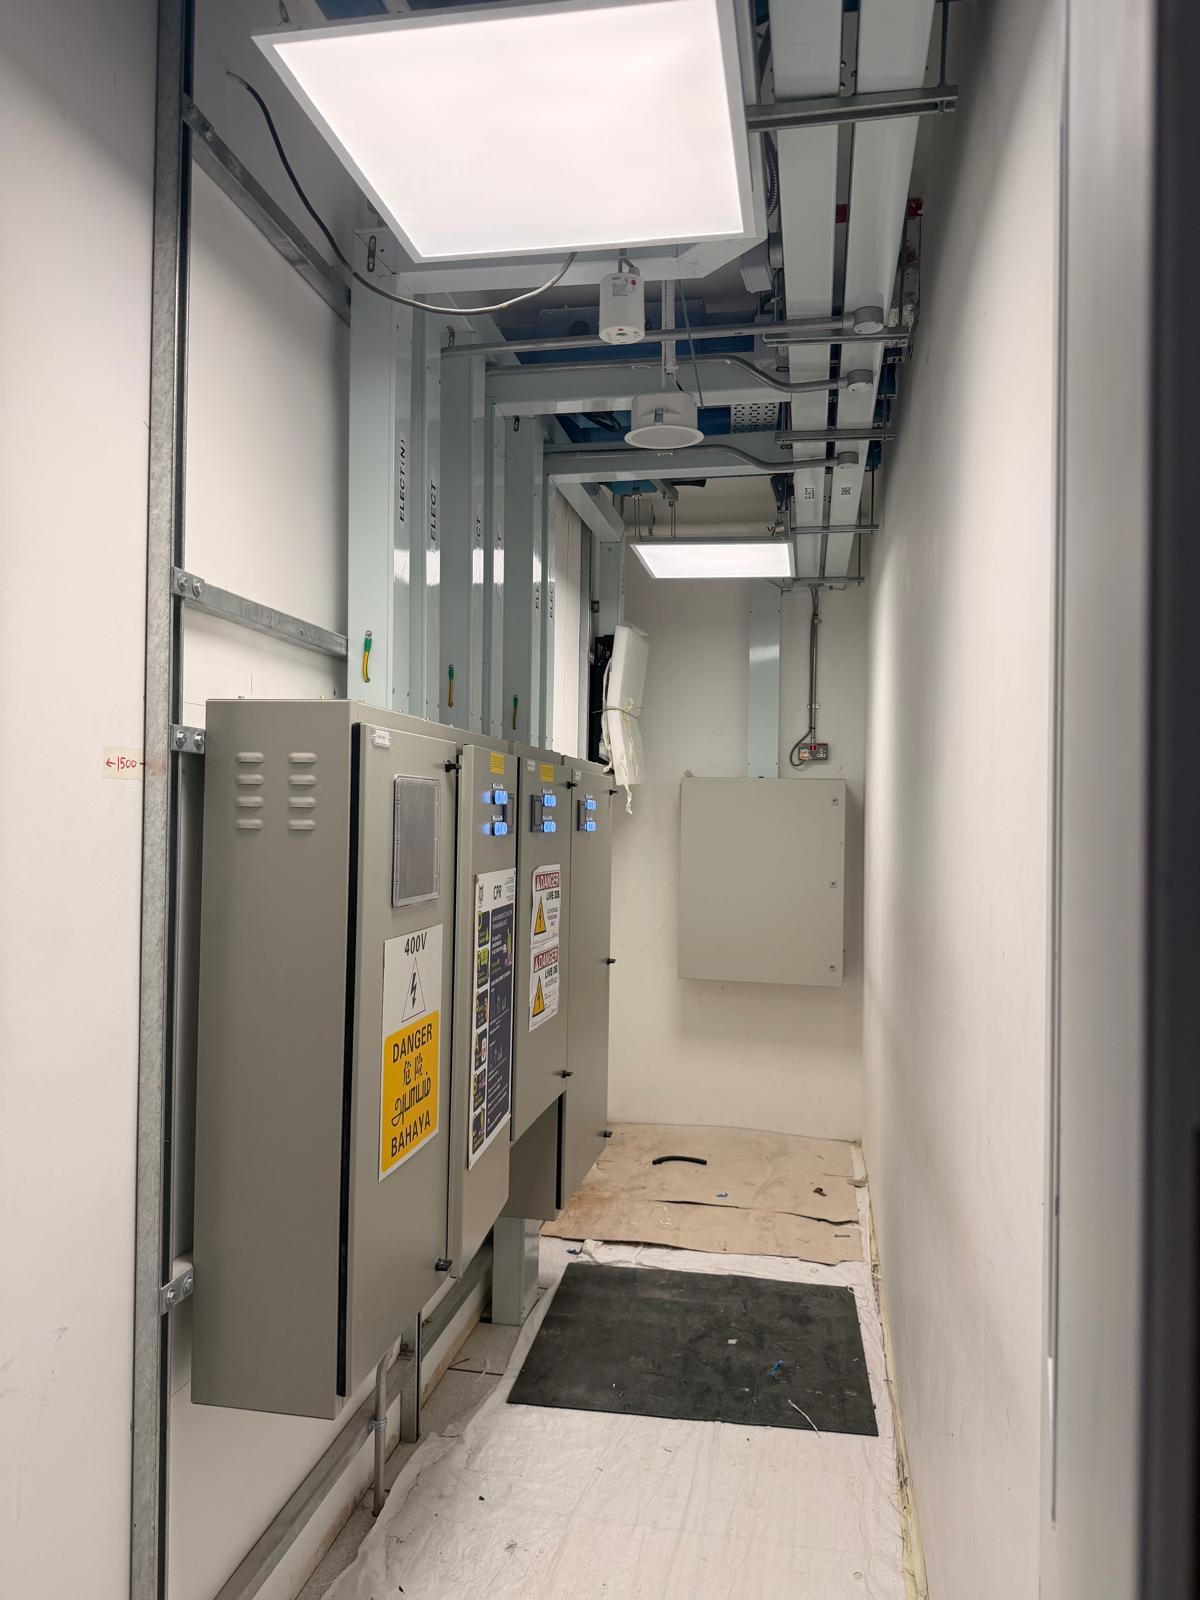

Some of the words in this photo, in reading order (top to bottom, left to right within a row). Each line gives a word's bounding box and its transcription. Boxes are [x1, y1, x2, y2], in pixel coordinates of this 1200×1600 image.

[117, 756, 138, 771] 1500
[493, 884, 502, 900] CPR
[404, 932, 428, 956] 400V
[392, 1022, 433, 1064] DANGER
[391, 1109, 431, 1158] BAHAYA
